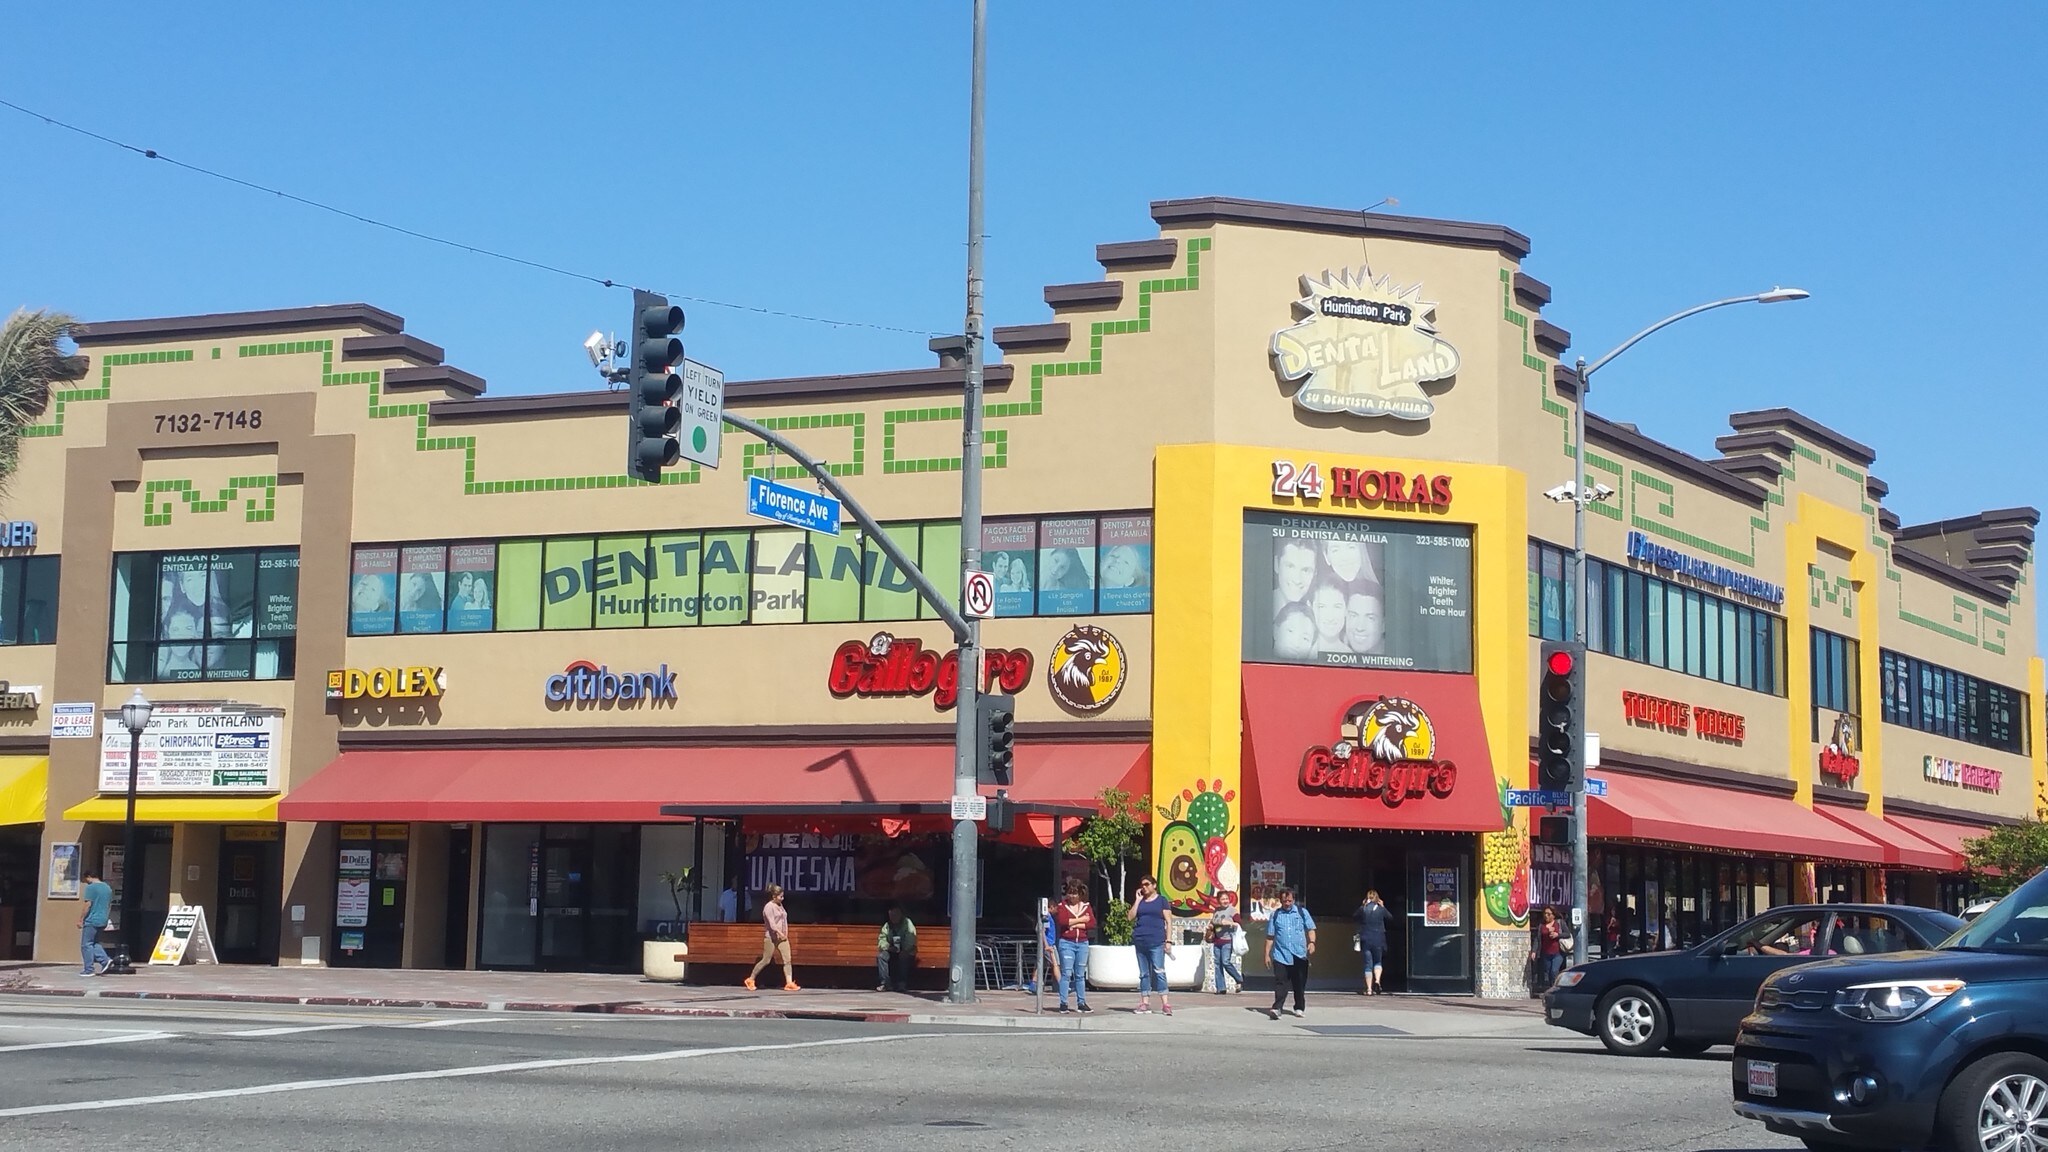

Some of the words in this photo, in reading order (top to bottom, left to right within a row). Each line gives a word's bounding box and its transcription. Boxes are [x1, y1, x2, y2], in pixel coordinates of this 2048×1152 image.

[1324, 300, 1378, 317] Huntington
[1383, 308, 1406, 322] Park
[686, 368, 701, 382] LEFT
[705, 375, 721, 389] TURN
[688, 385, 717, 406] YIELD
[1306, 392, 1319, 403] SU
[1323, 395, 1374, 408] DENTISTA
[1378, 400, 1429, 414] FAMILIAR
[685, 402, 694, 414] ON
[697, 407, 718, 423] GREEN
[155, 409, 262, 433] 7132-7148
[1274, 460, 1325, 498] 24
[1332, 467, 1453, 506] HORAS
[759, 485, 805, 514] Florence
[808, 499, 828, 520] Ave
[984, 526, 1008, 534] PAGOS
[1103, 521, 1133, 530] DENTISTA
[1281, 518, 1370, 532] DENTALAND
[0, 520, 35, 547] JER
[1053, 537, 1085, 545] DENTALES
[1120, 529, 1148, 538] FAMILIA
[1272, 528, 1286, 537] SU
[1291, 530, 1340, 541] DENTISTA
[1345, 533, 1388, 544] FAMILIA
[1416, 535, 1470, 547] 323-585-1000
[259, 559, 300, 568] 323-585-100
[544, 540, 919, 605] DENTALAND
[1428, 586, 1458, 597] Brighter
[600, 592, 743, 617] Huntington
[752, 589, 805, 610] Park
[1432, 596, 1454, 606] Teeth
[1420, 606, 1427, 615] In
[1429, 606, 1446, 616] One
[1447, 608, 1466, 617] Hour
[1327, 653, 1357, 664] ZOOM
[1362, 655, 1414, 667] WHITENING
[177, 671, 202, 679] ZOOM
[206, 670, 249, 679] WHITENING
[344, 666, 443, 698] DOLEX
[546, 663, 677, 701] citibank
[934, 648, 1034, 711] gro
[54, 716, 68, 725] FOR
[71, 716, 92, 725] LEASE
[168, 719, 188, 728] Park
[198, 715, 264, 728] DENTALAND
[1622, 690, 1690, 729] TORTAS
[1693, 706, 1745, 740] TACOS
[160, 735, 214, 748] CHIROPRACTIC
[1411, 748, 1425, 756] 1987
[1508, 791, 1546, 805] Pacific
[745, 856, 856, 891] UARESMA
[1530, 868, 1574, 906] UARESM
